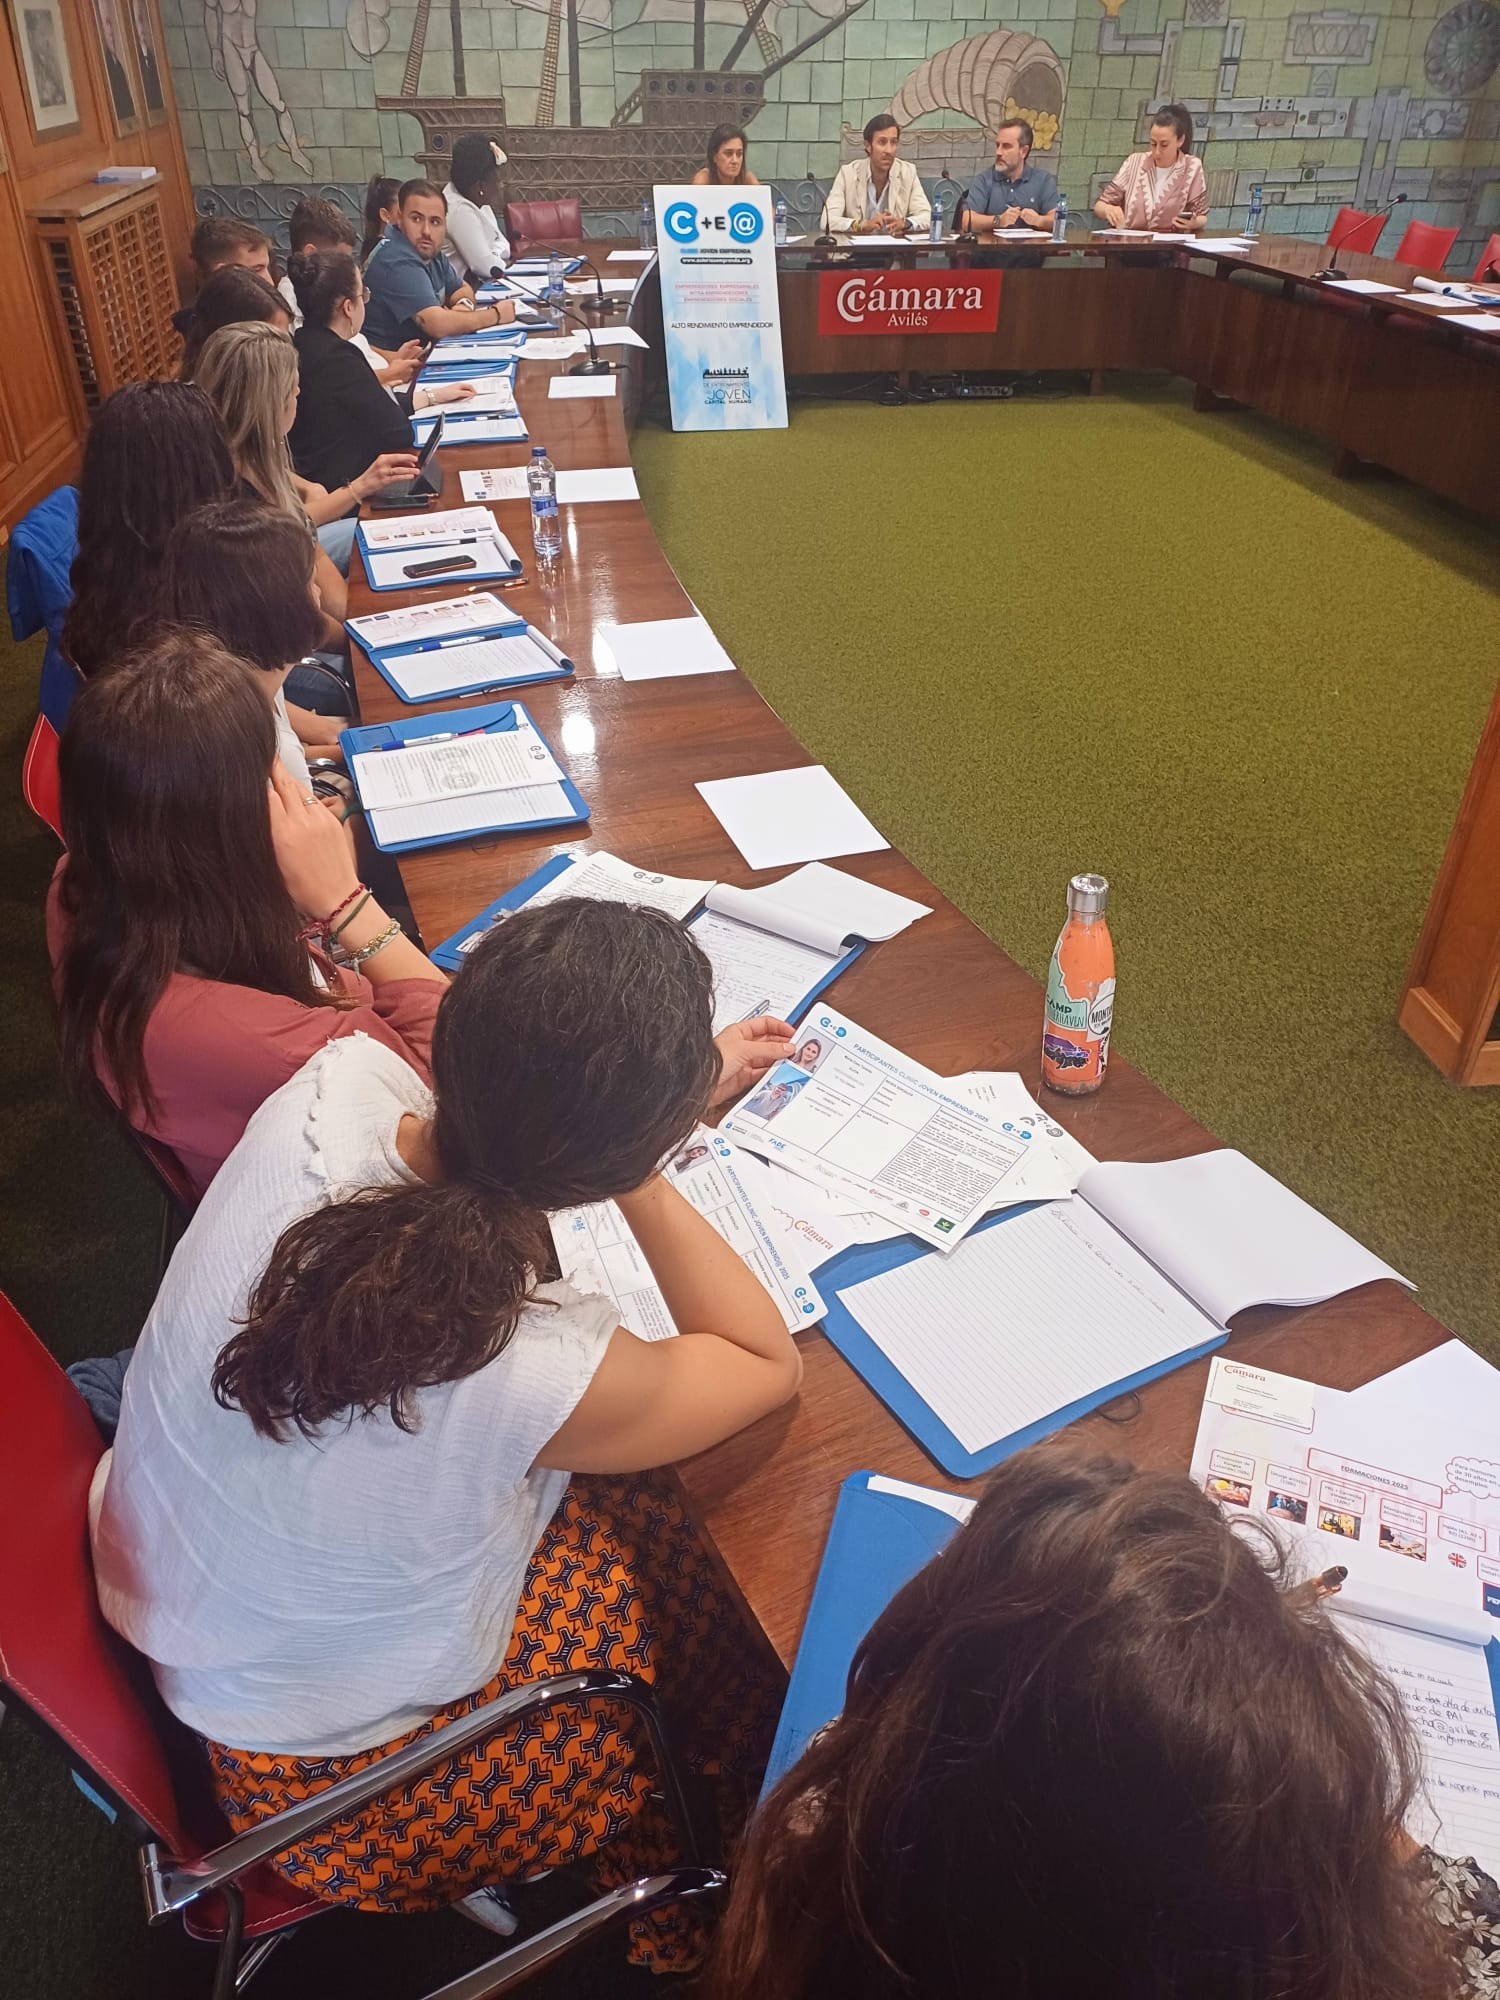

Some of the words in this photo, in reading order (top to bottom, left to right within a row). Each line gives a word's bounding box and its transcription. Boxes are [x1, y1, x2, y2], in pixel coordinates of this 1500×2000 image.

[887, 311, 928, 326] Avilés
[707, 388, 751, 400] JOVEN
[853, 1043, 899, 1074] PARTICIPANTES
[898, 1071, 919, 1087] CLINIC
[918, 1080, 939, 1097] JOVEN
[974, 1111, 989, 1123] 2025
[726, 1164, 749, 1203] PARTICIPANTES
[745, 1202, 758, 1219] CLINIC
[754, 1219, 767, 1237] JOVEN
[794, 1220, 834, 1250] Cámara
[1341, 1465, 1391, 1485] FORMACIONES
[1392, 1480, 1409, 1490] 2025
[1455, 1463, 1468, 1471] Para
[1469, 1468, 1497, 1479] menores
[1473, 1474, 1488, 1483] años
